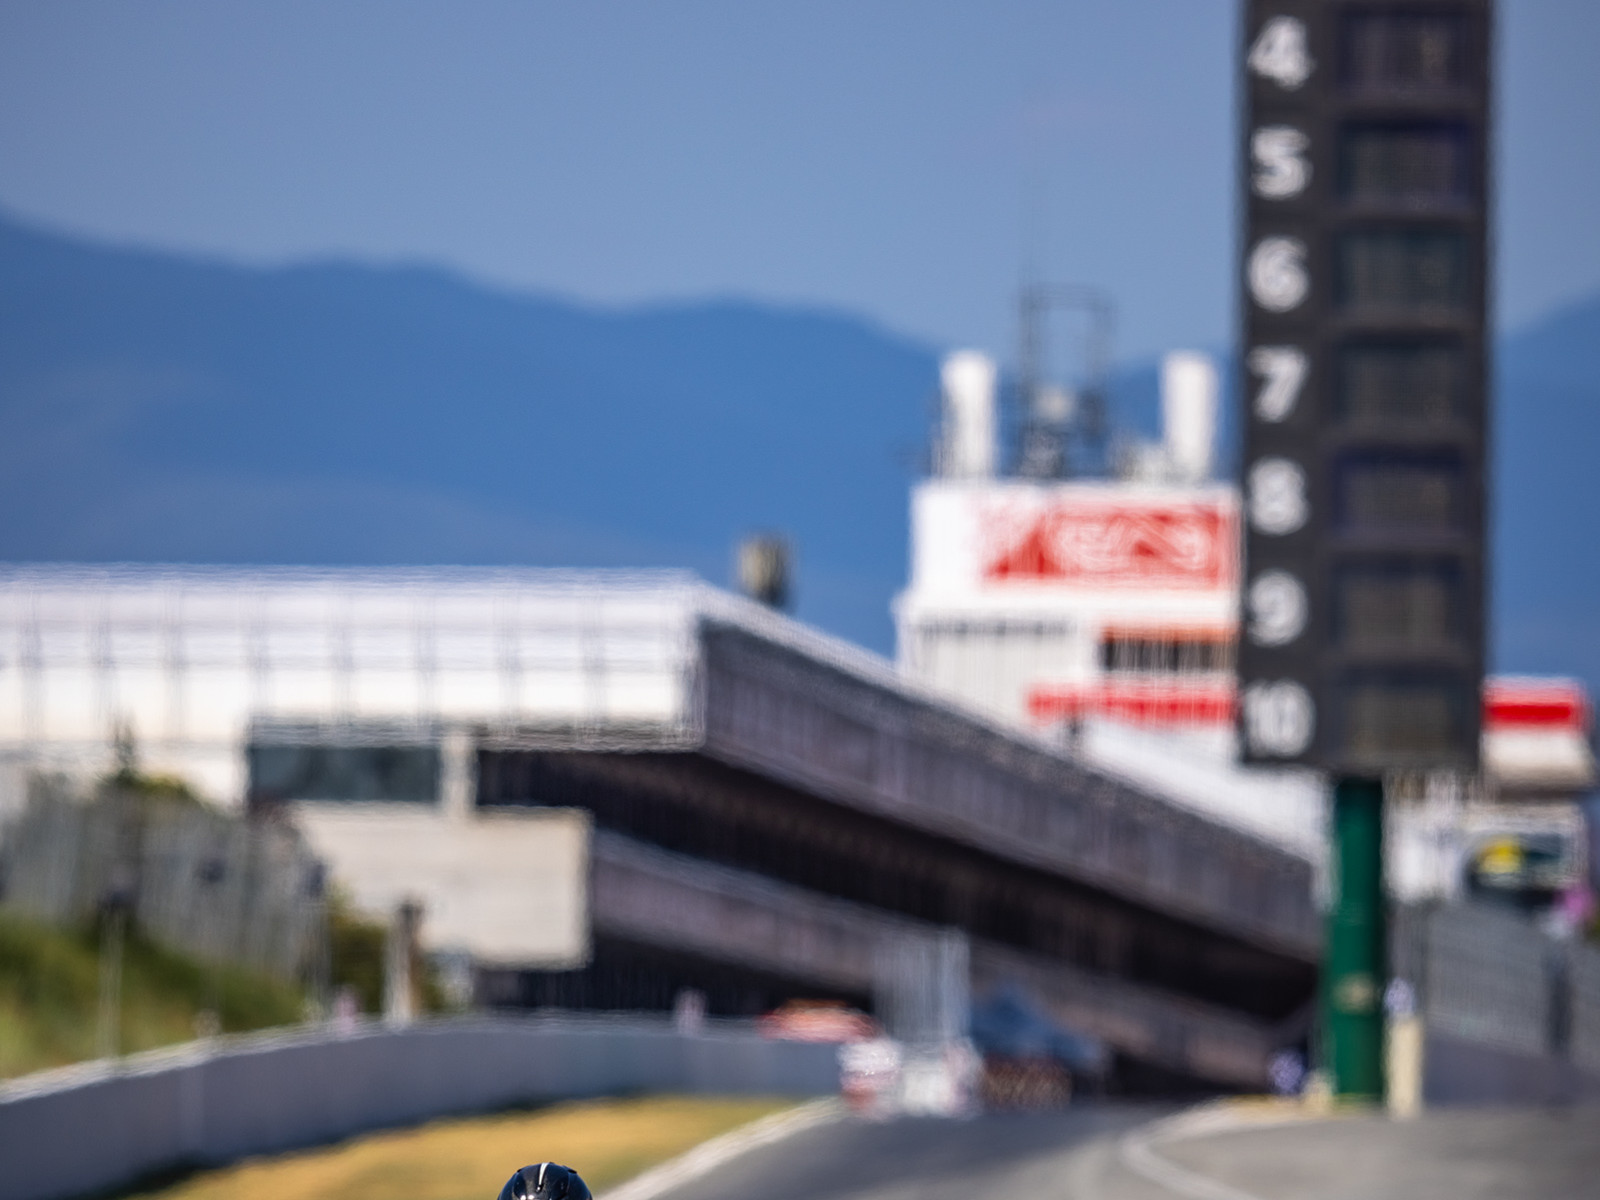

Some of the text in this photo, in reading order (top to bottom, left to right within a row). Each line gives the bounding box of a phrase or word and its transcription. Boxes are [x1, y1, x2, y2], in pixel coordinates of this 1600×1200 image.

[1249, 14, 1313, 89] 4
[1251, 126, 1311, 198] 5
[1249, 237, 1307, 311] 6
[1249, 346, 1307, 422] 7
[1249, 457, 1308, 534] 8
[1250, 569, 1307, 645] 9
[1246, 682, 1315, 756] 10
